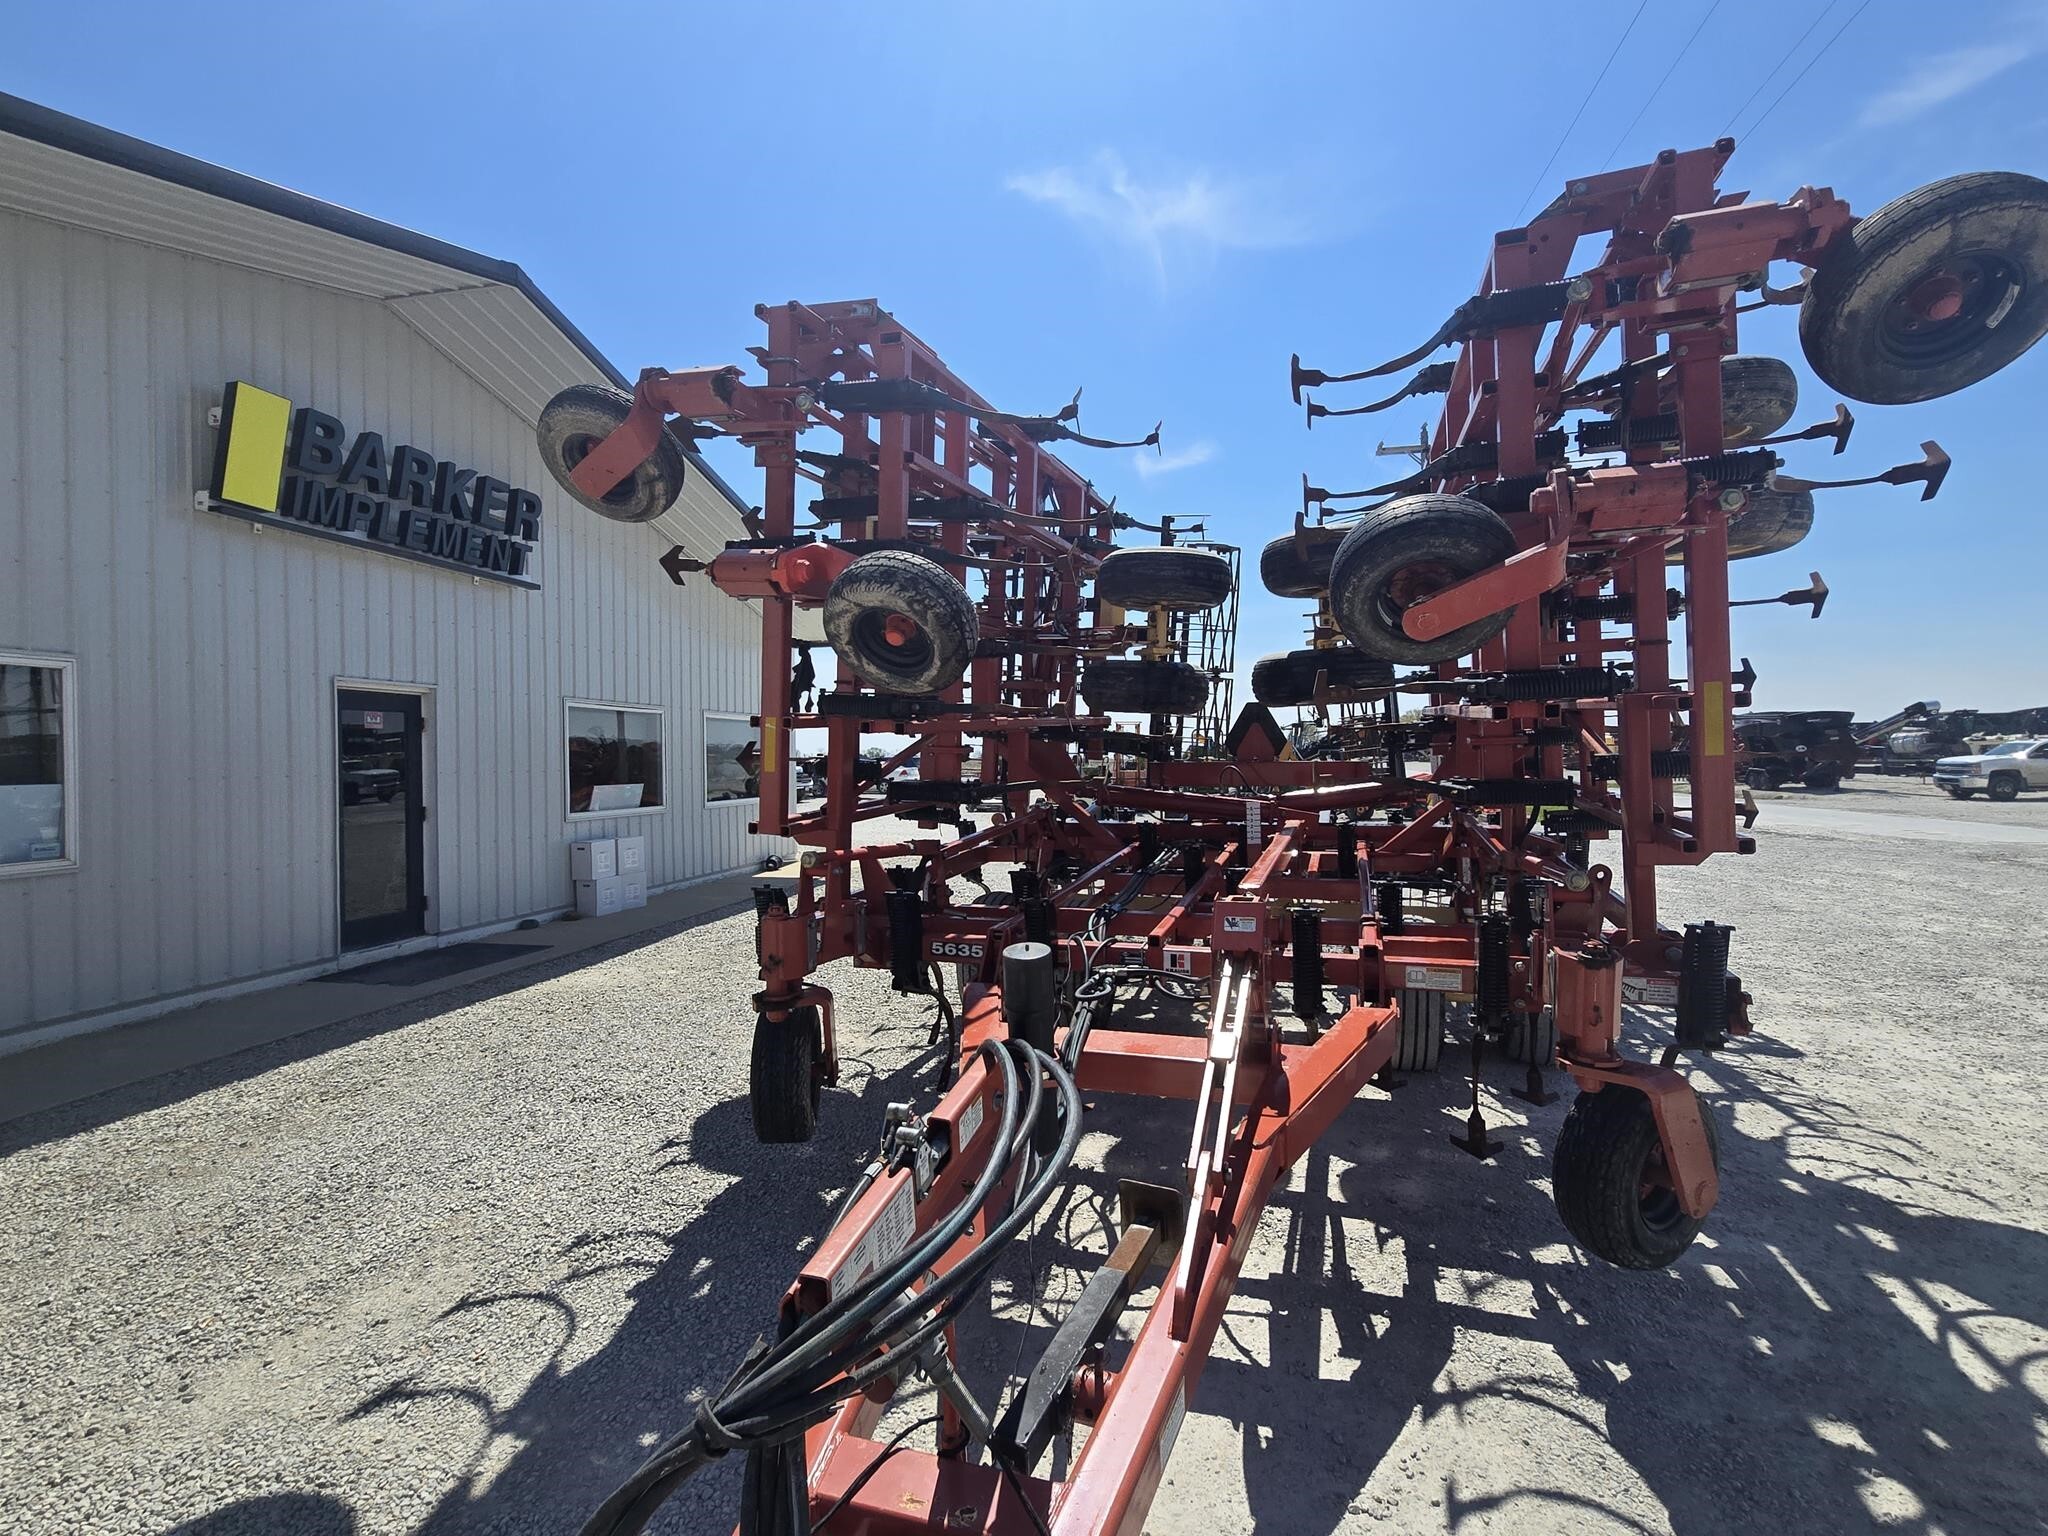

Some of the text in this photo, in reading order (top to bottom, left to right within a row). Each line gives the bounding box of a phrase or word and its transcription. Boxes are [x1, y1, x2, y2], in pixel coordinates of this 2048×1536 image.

[288, 407, 543, 541] BARKER
[280, 475, 533, 575] IMPLEMENT
[931, 942, 983, 958] 5635
